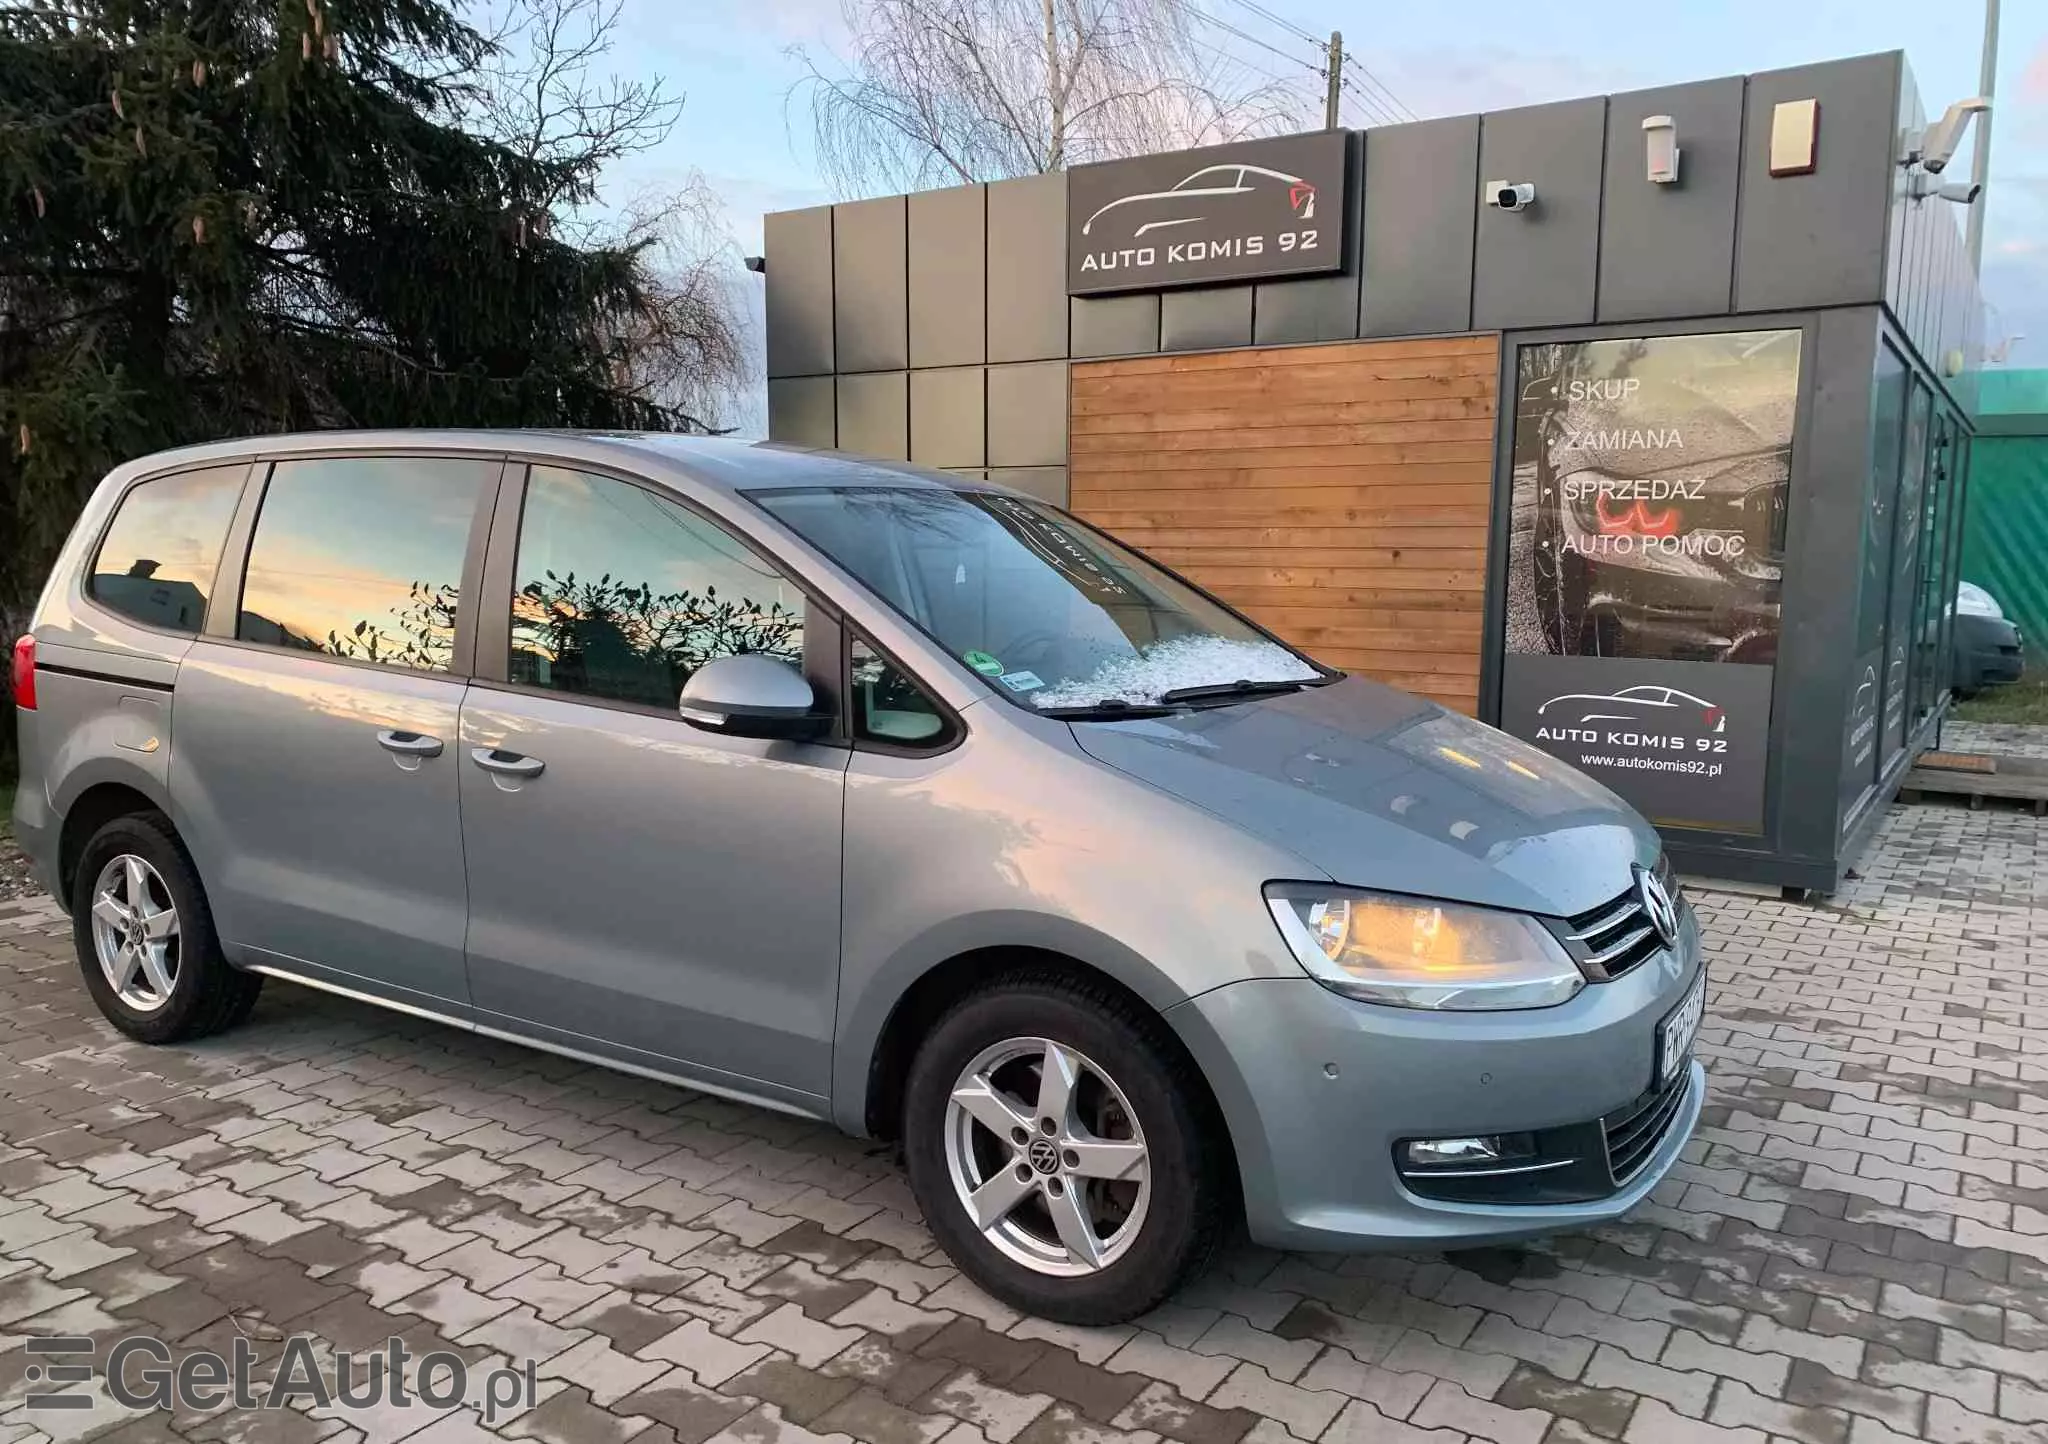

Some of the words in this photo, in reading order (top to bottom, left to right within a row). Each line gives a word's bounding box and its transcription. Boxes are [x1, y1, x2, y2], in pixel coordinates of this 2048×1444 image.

[1080, 247, 1155, 272] AUTO
[1167, 235, 1264, 264] KOMIS
[1278, 229, 1319, 252] 92
[1568, 378, 1640, 401] SKUP
[1565, 427, 1684, 450] ZAMIANA
[1561, 534, 1634, 555] AUTO
[1642, 534, 1746, 556] POMOC
[1535, 727, 1598, 743] AUTO
[1607, 732, 1685, 750] KOMIS
[1696, 739, 1729, 753] 92
[1581, 753, 1723, 777] www.autokomis92.pl
